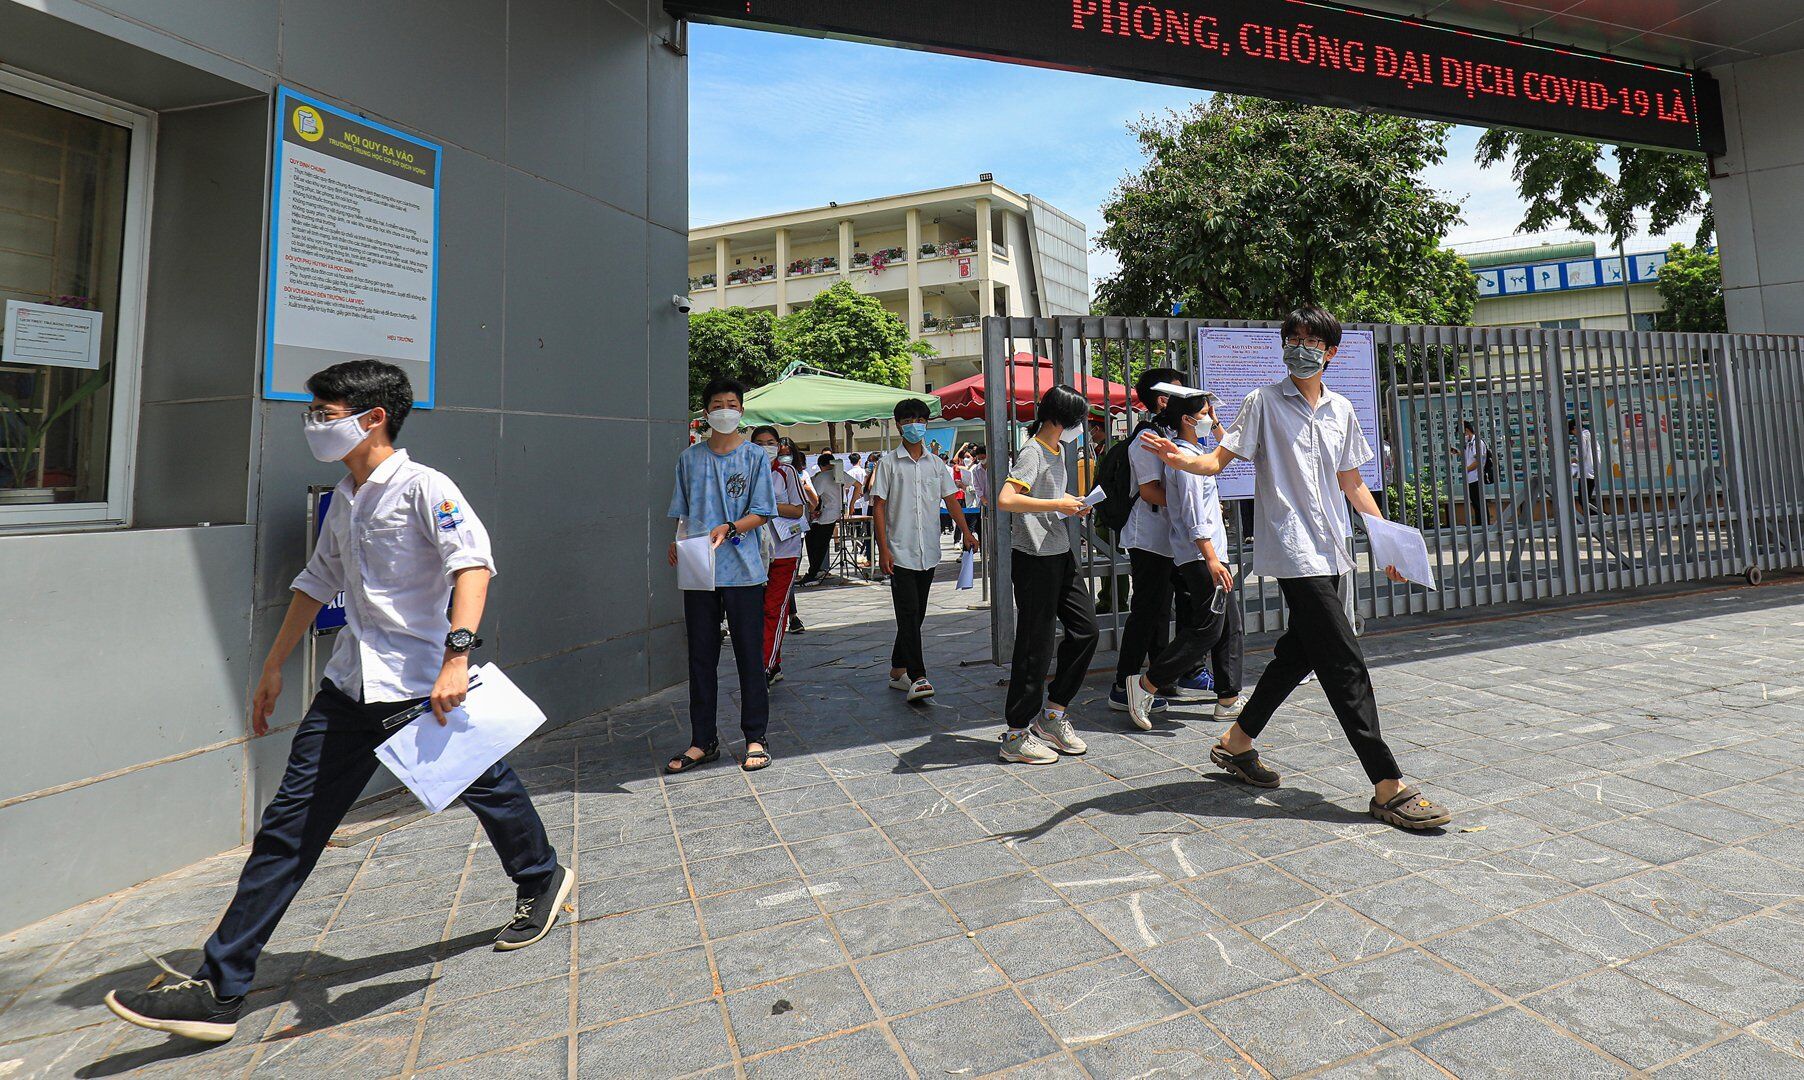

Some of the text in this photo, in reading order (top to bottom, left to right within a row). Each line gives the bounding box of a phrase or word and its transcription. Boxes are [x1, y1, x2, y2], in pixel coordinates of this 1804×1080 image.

[1239, 23, 1367, 73] CHỐNG
[1374, 46, 1432, 90] ĐẠI
[1441, 56, 1517, 99] DỊCH
[1523, 71, 1651, 115] COVID-19
[1656, 88, 1690, 123] LÀ
[344, 131, 413, 164] NỘI QUY RA VÀO
